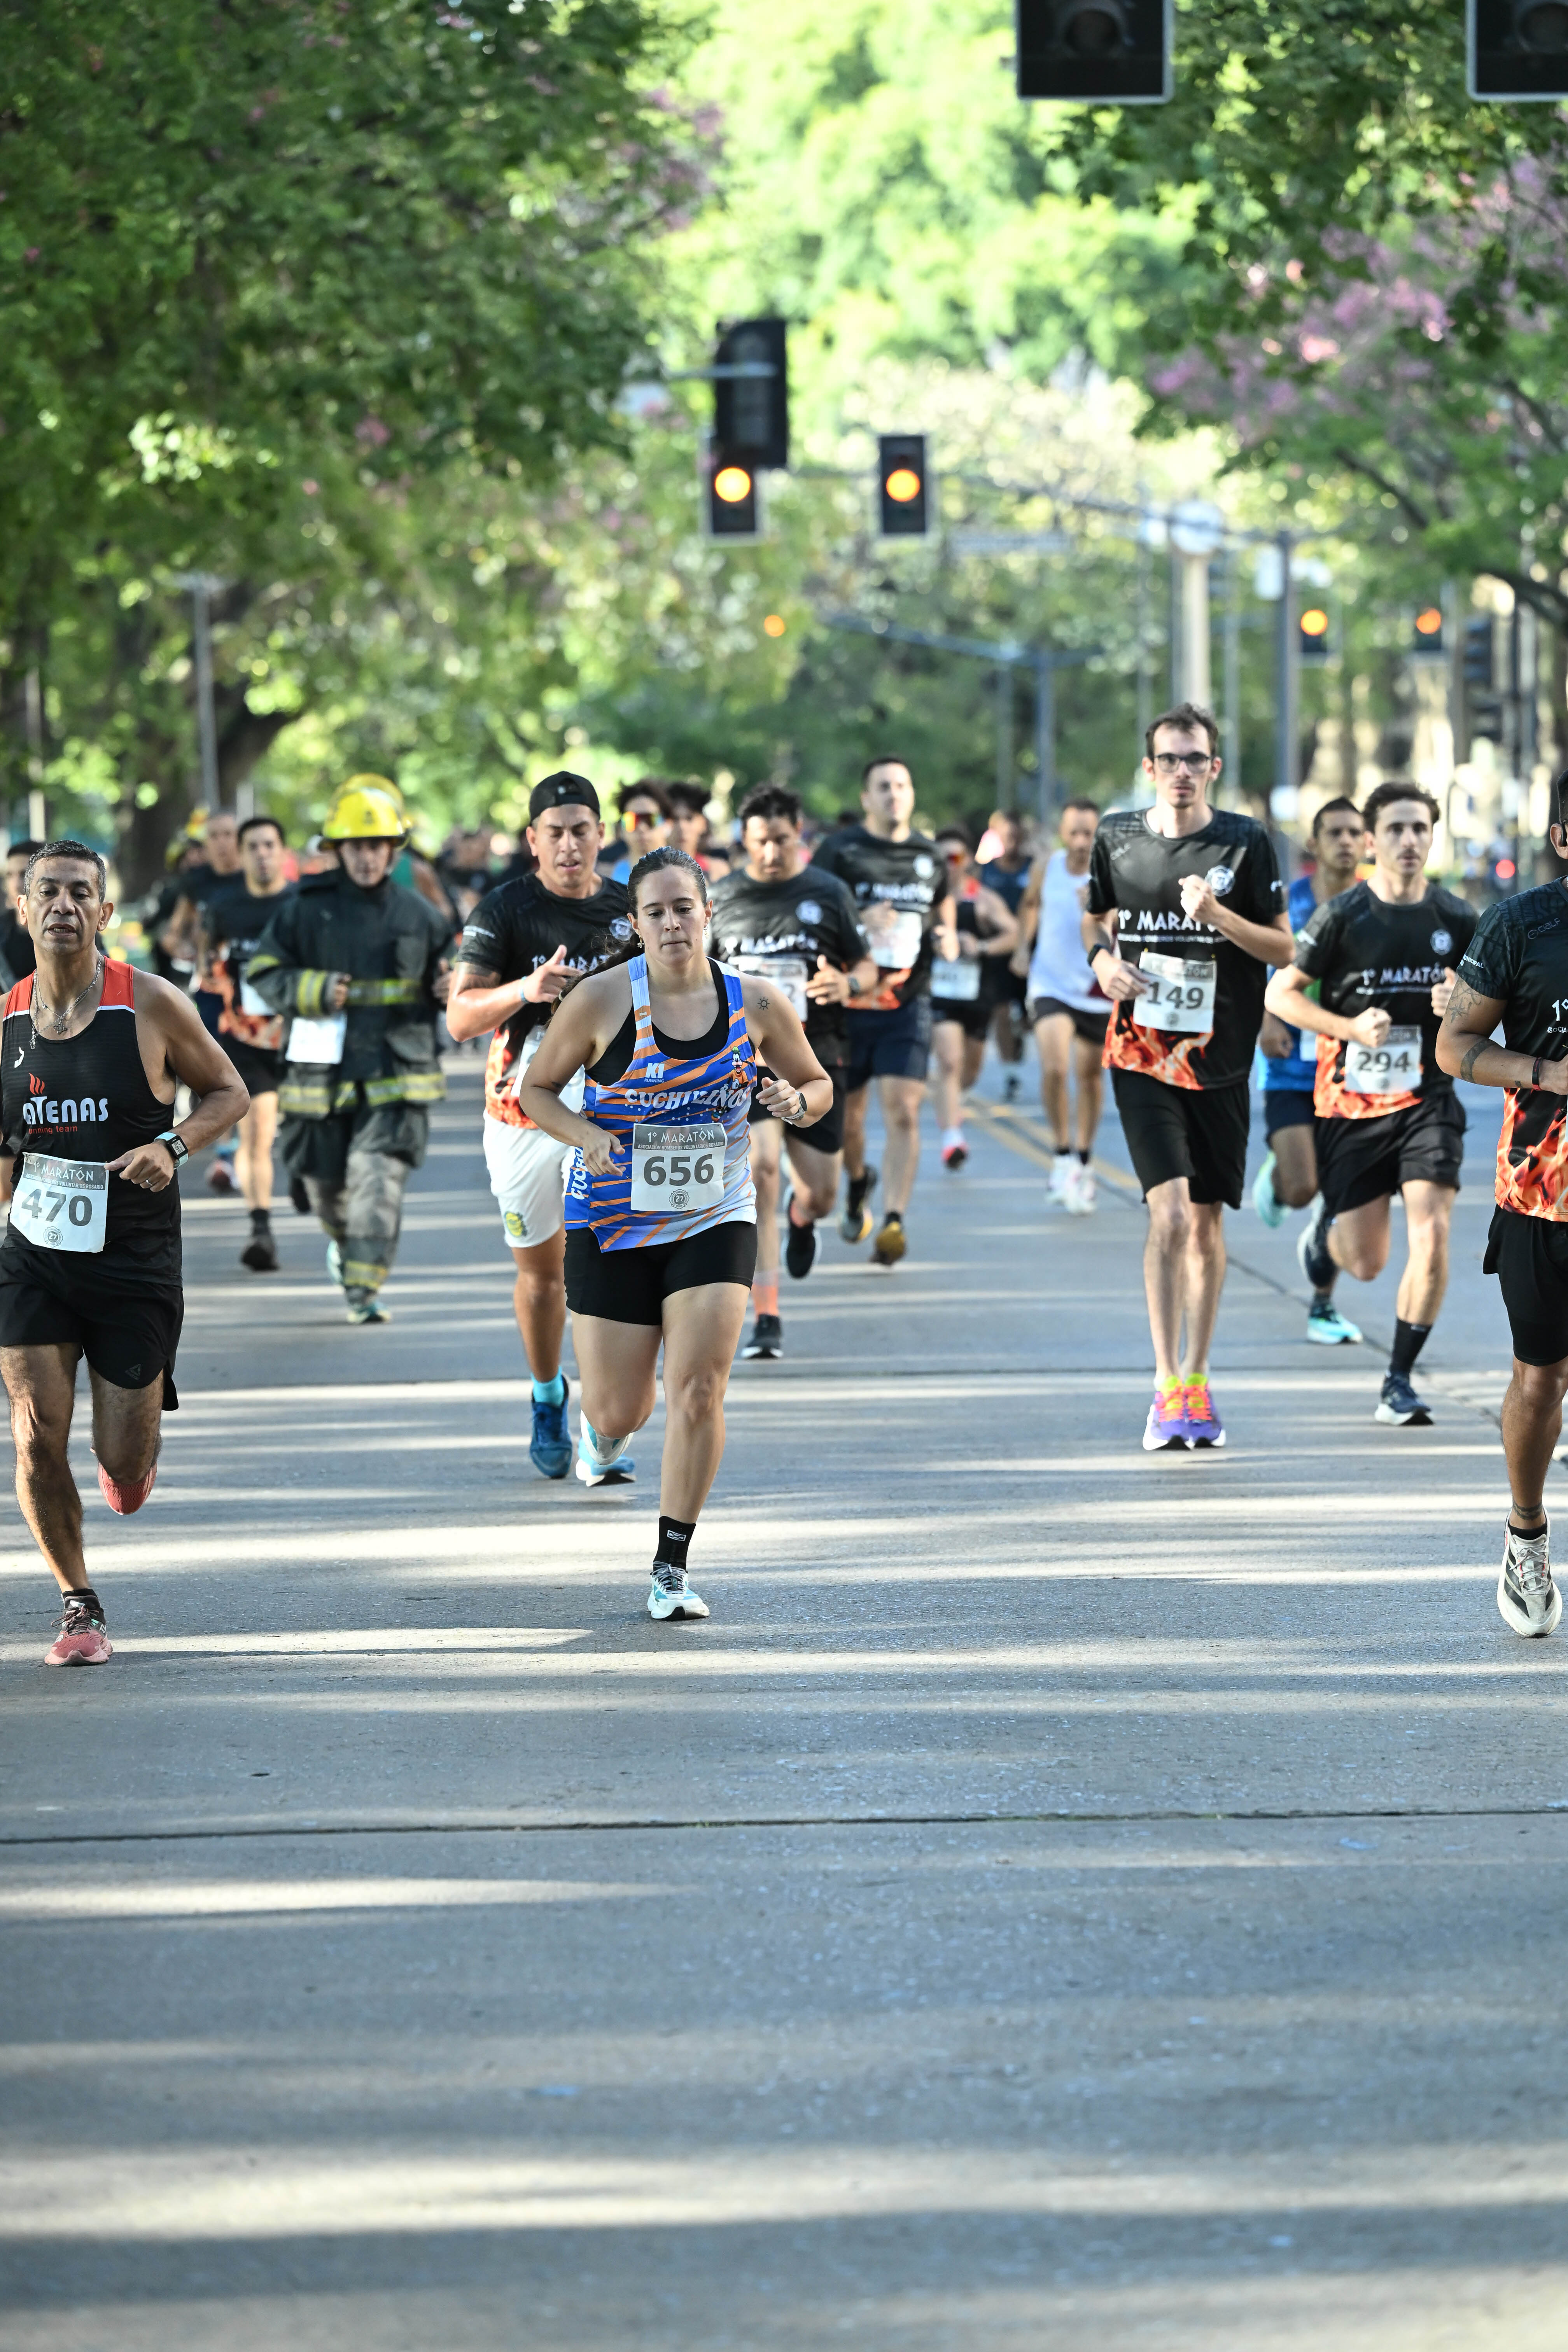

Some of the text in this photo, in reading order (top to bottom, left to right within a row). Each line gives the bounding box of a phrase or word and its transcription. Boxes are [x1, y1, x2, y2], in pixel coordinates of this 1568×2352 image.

[1136, 910, 1217, 932] MARA
[1463, 954, 1484, 968] UNICIPAL
[1147, 982, 1204, 1010] 149
[1358, 1051, 1411, 1073] 294
[661, 1127, 714, 1143] MARATÓN
[41, 1164, 94, 1181] MARATÓN
[643, 1153, 714, 1186] 656
[21, 1188, 93, 1226] 470
